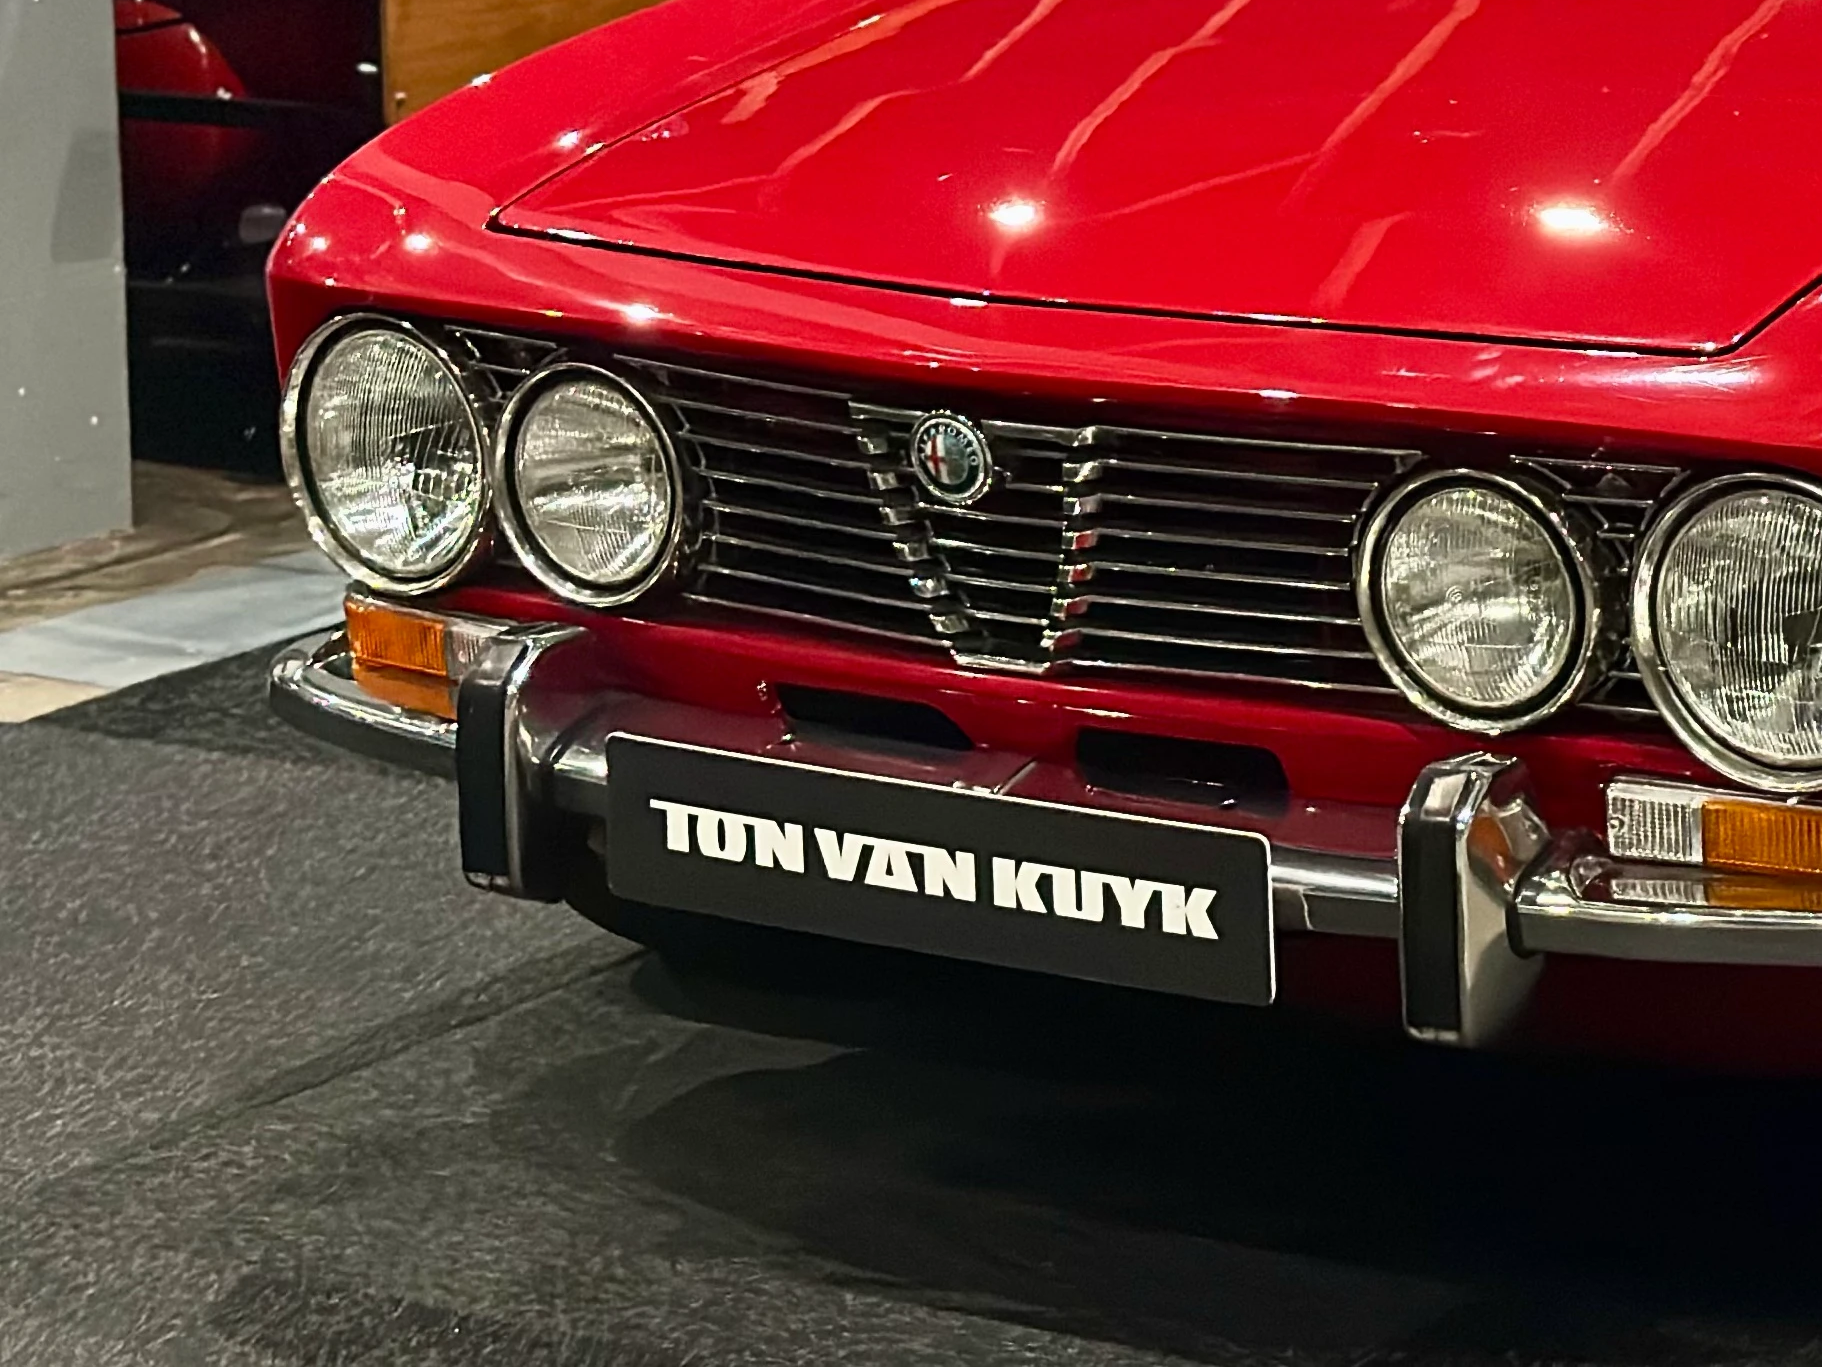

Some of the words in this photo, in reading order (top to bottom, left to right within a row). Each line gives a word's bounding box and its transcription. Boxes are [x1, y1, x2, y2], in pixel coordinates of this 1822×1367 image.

[649, 798, 805, 874] TON
[812, 826, 977, 904] VAN
[991, 856, 1220, 941] KUYK
